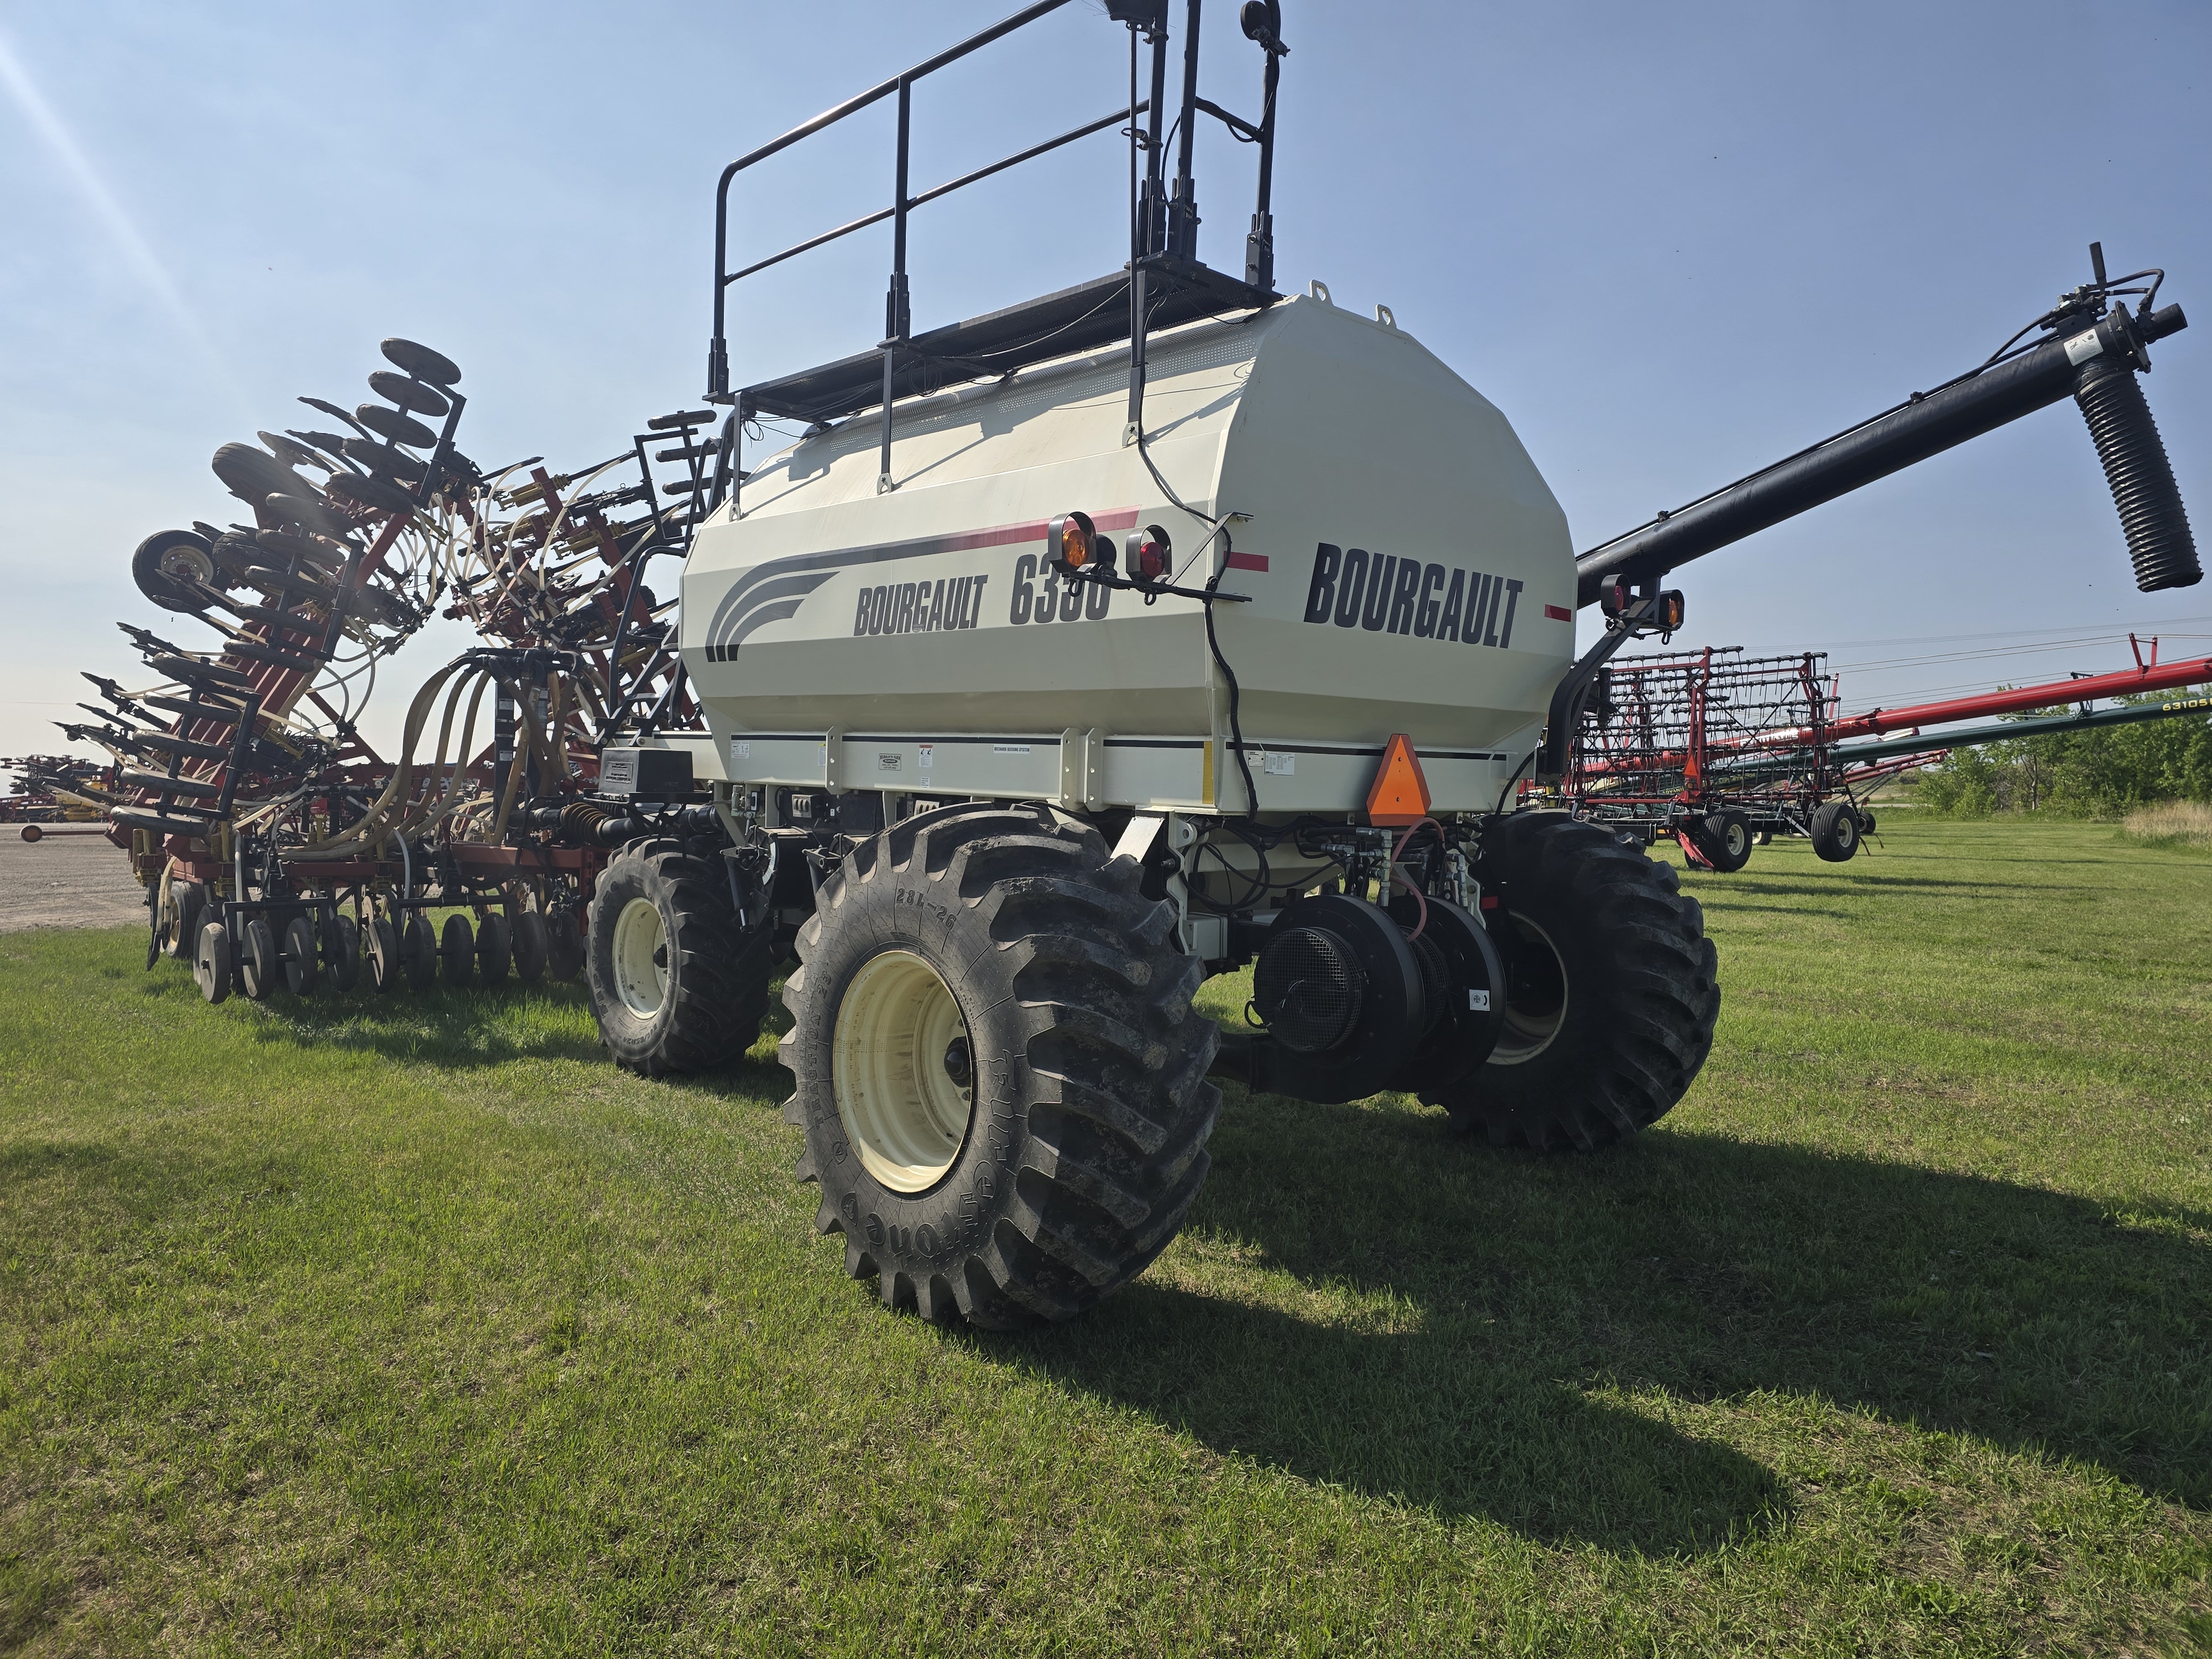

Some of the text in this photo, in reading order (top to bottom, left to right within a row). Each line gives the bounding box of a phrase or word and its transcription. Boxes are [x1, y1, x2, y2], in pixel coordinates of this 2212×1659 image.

[854, 574, 988, 637] BOURGAULT
[1303, 542, 1524, 649] BOURGAULT
[896, 888, 957, 930] 28L-26
[808, 1010, 823, 1130] TRACTION
[866, 1049, 1018, 1258] Firestone
